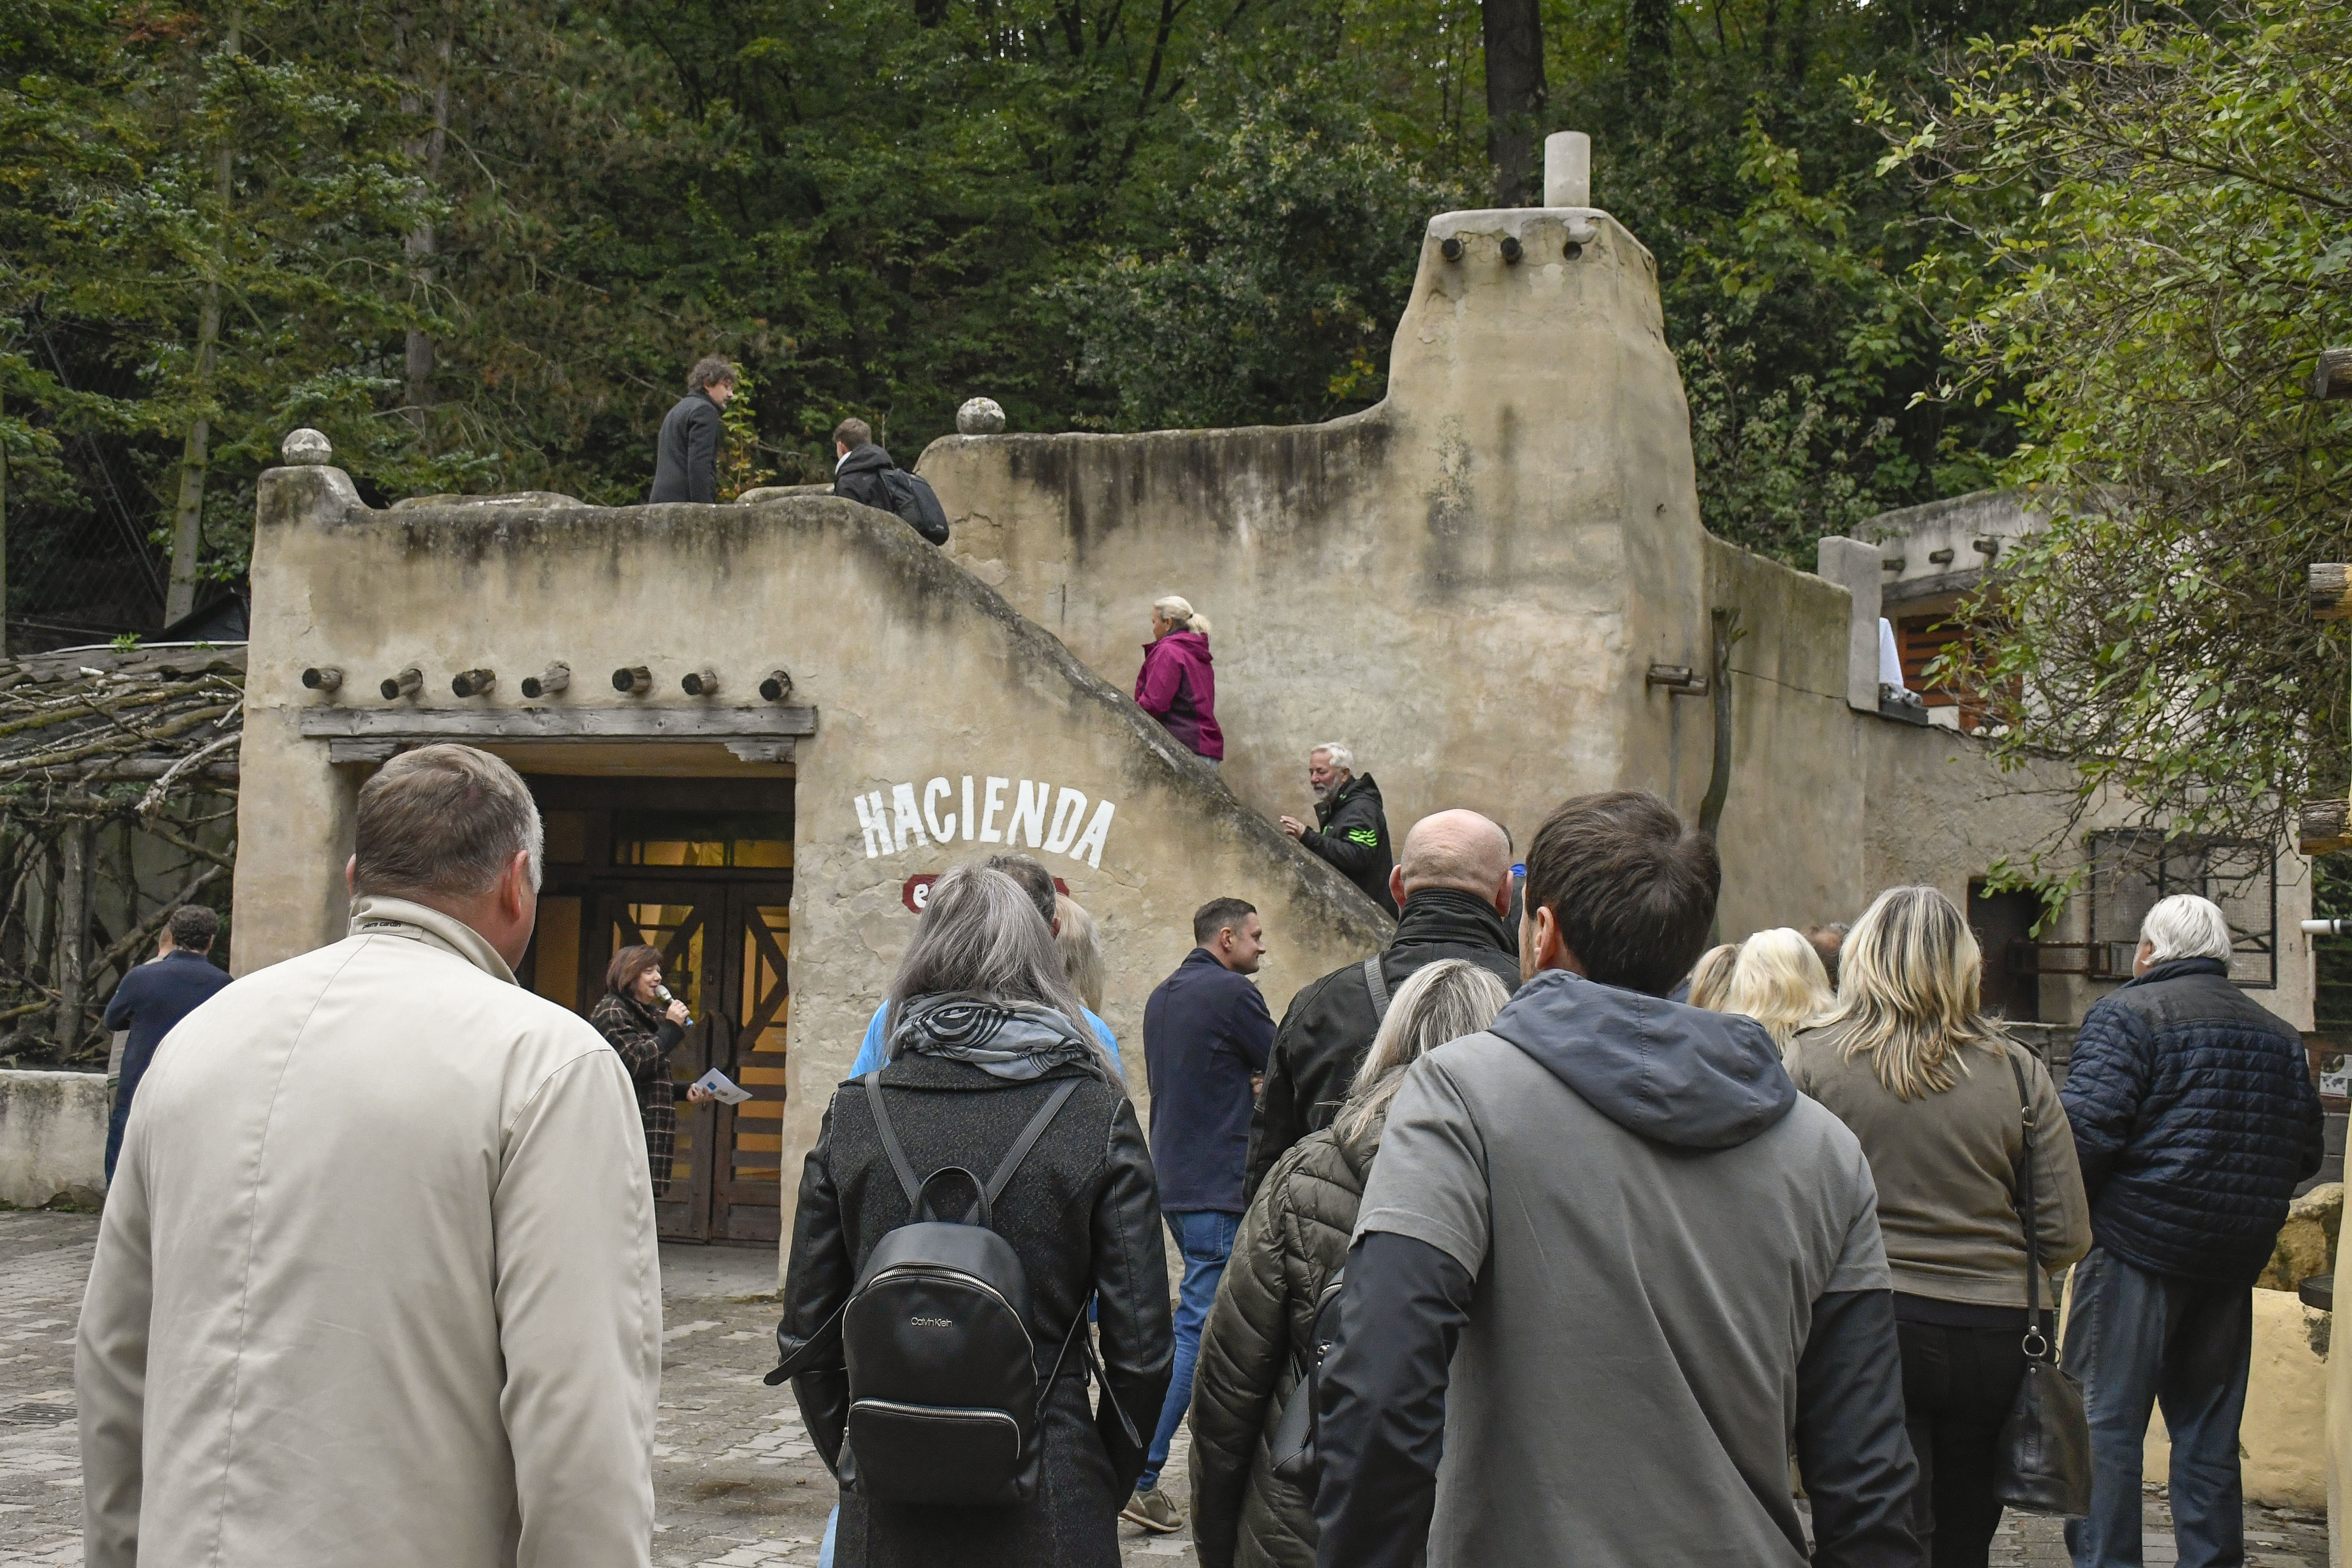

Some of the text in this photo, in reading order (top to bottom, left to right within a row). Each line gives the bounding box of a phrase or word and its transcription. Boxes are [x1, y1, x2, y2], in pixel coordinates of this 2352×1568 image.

[854, 775, 1115, 869] HACIENDA
[911, 1317, 952, 1327] Calvin Klein
